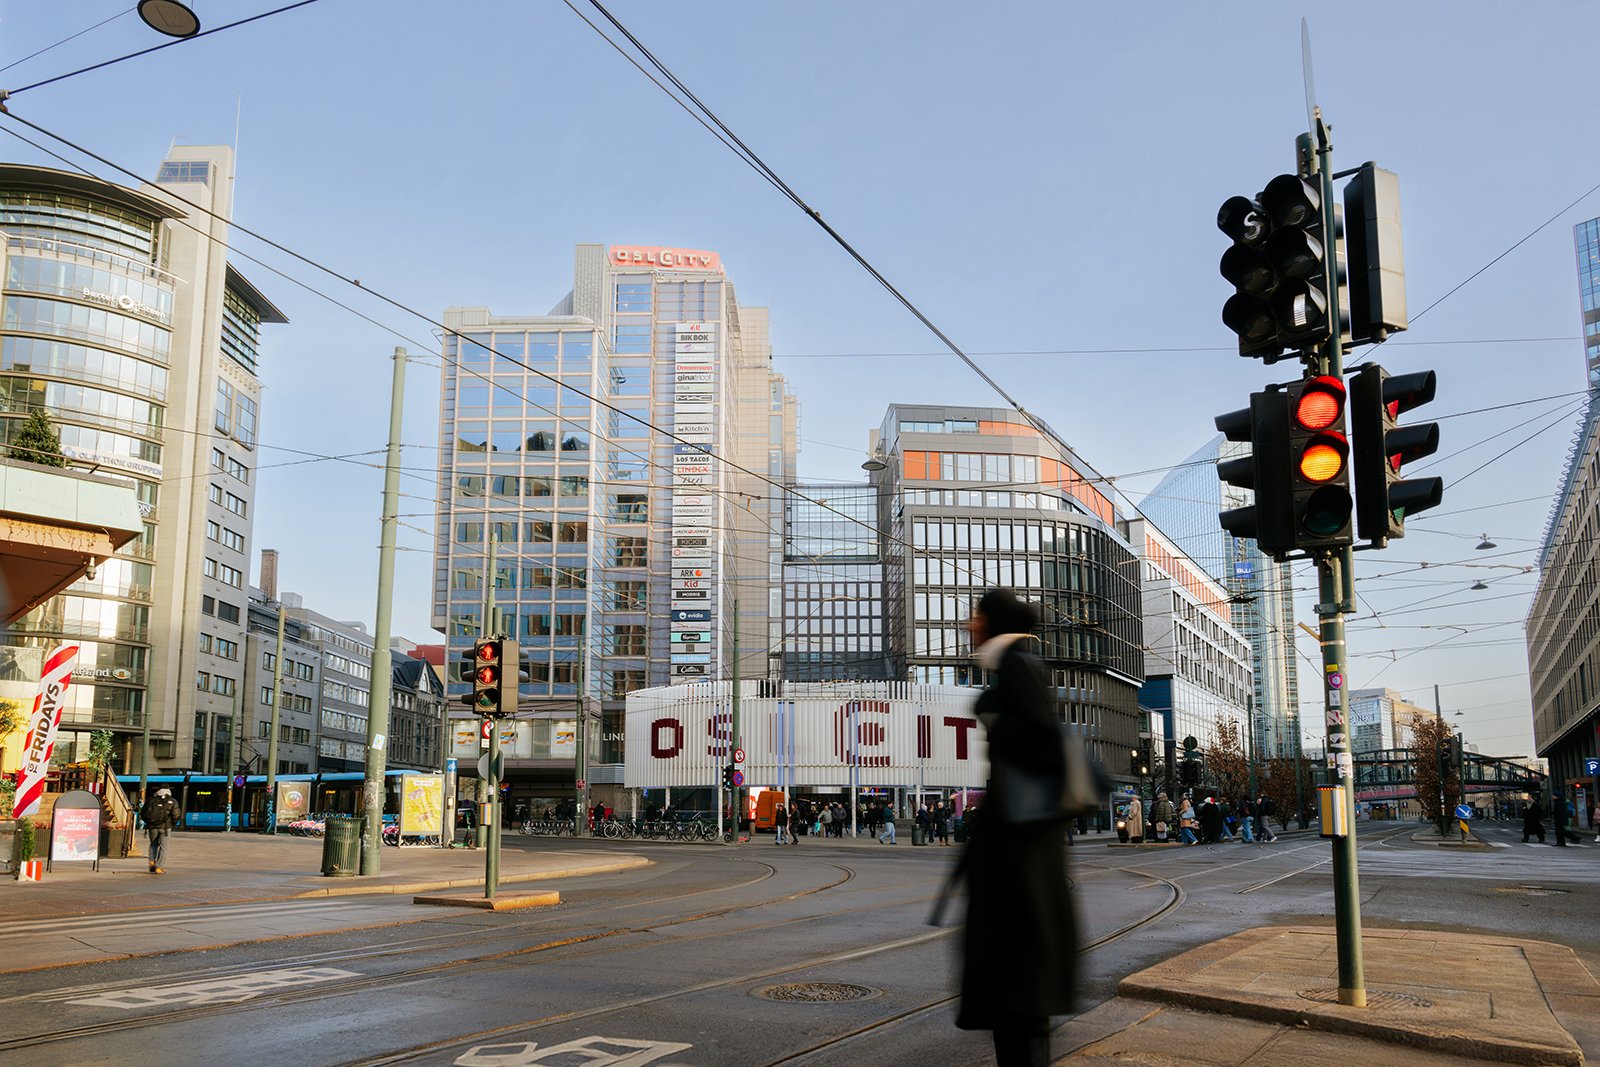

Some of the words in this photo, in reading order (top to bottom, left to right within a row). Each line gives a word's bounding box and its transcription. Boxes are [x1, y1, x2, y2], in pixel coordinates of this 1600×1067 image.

[680, 569, 694, 577] ARK
[683, 580, 699, 588] Kid
[30, 683, 60, 763] FRIDAYS
